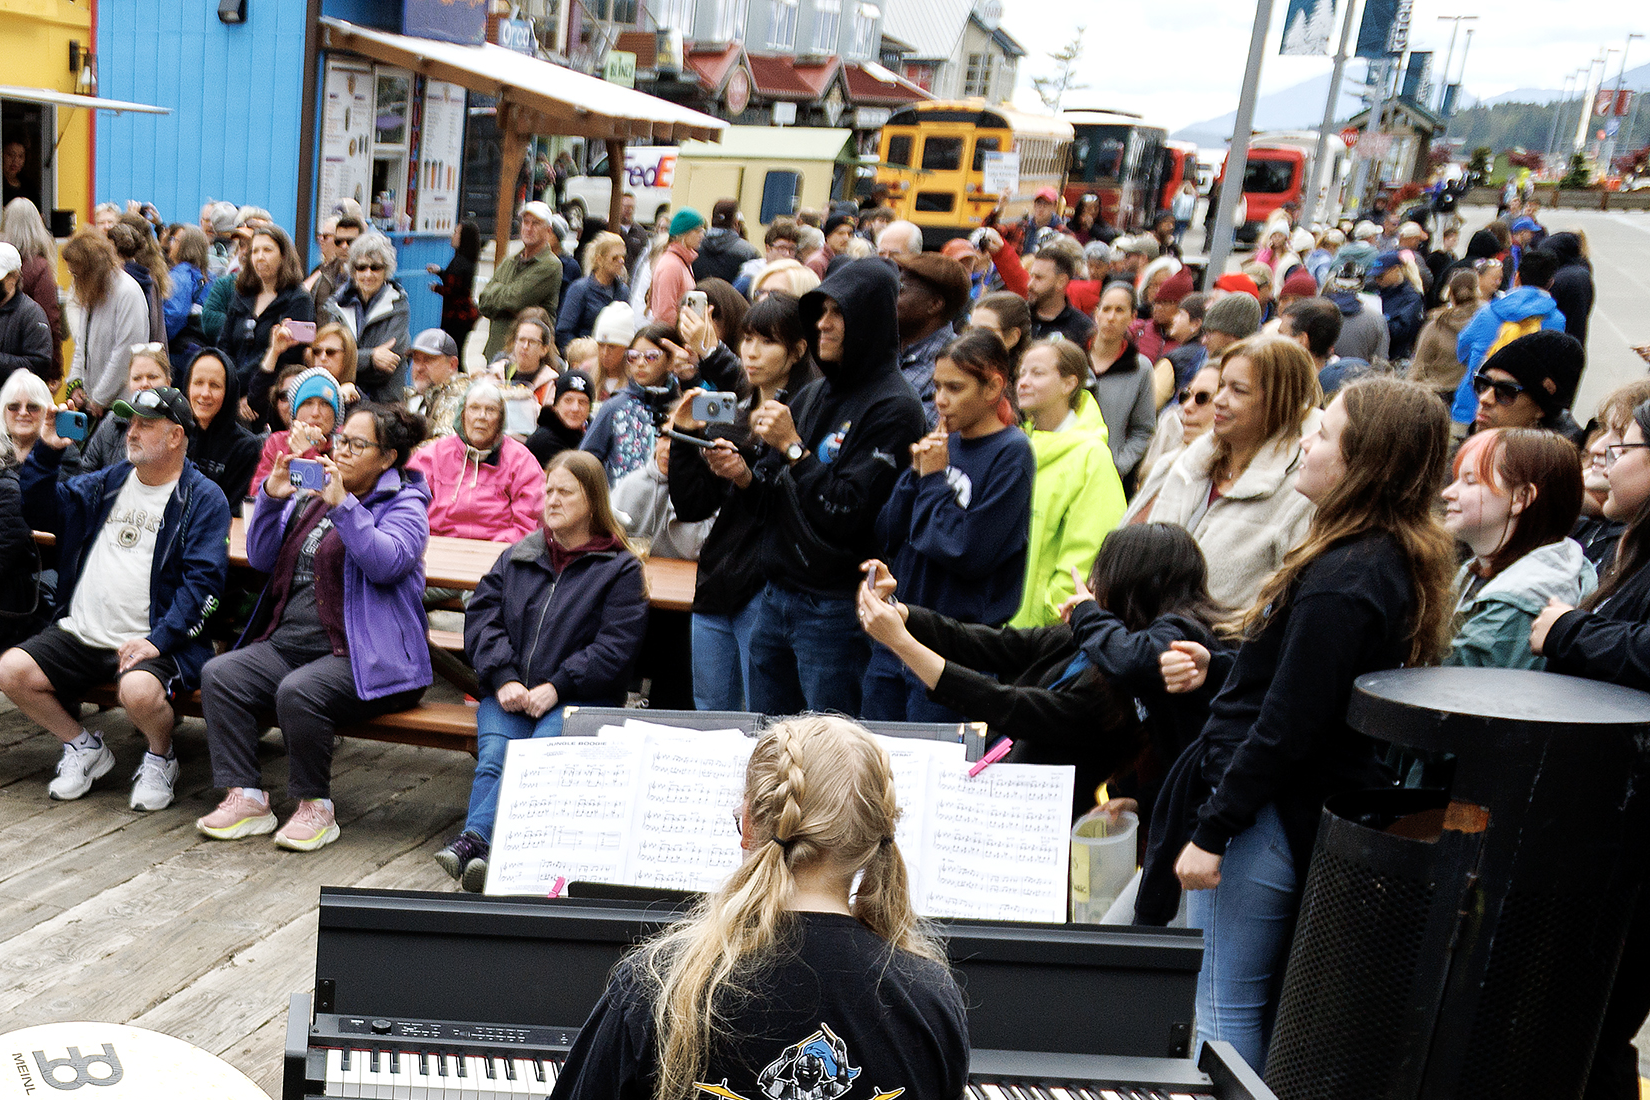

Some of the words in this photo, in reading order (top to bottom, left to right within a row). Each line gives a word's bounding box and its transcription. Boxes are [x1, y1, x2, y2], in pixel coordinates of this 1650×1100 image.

[503, 21, 530, 47] Orca
[1341, 134, 1358, 147] STOP
[11, 1052, 36, 1096] MEINL
